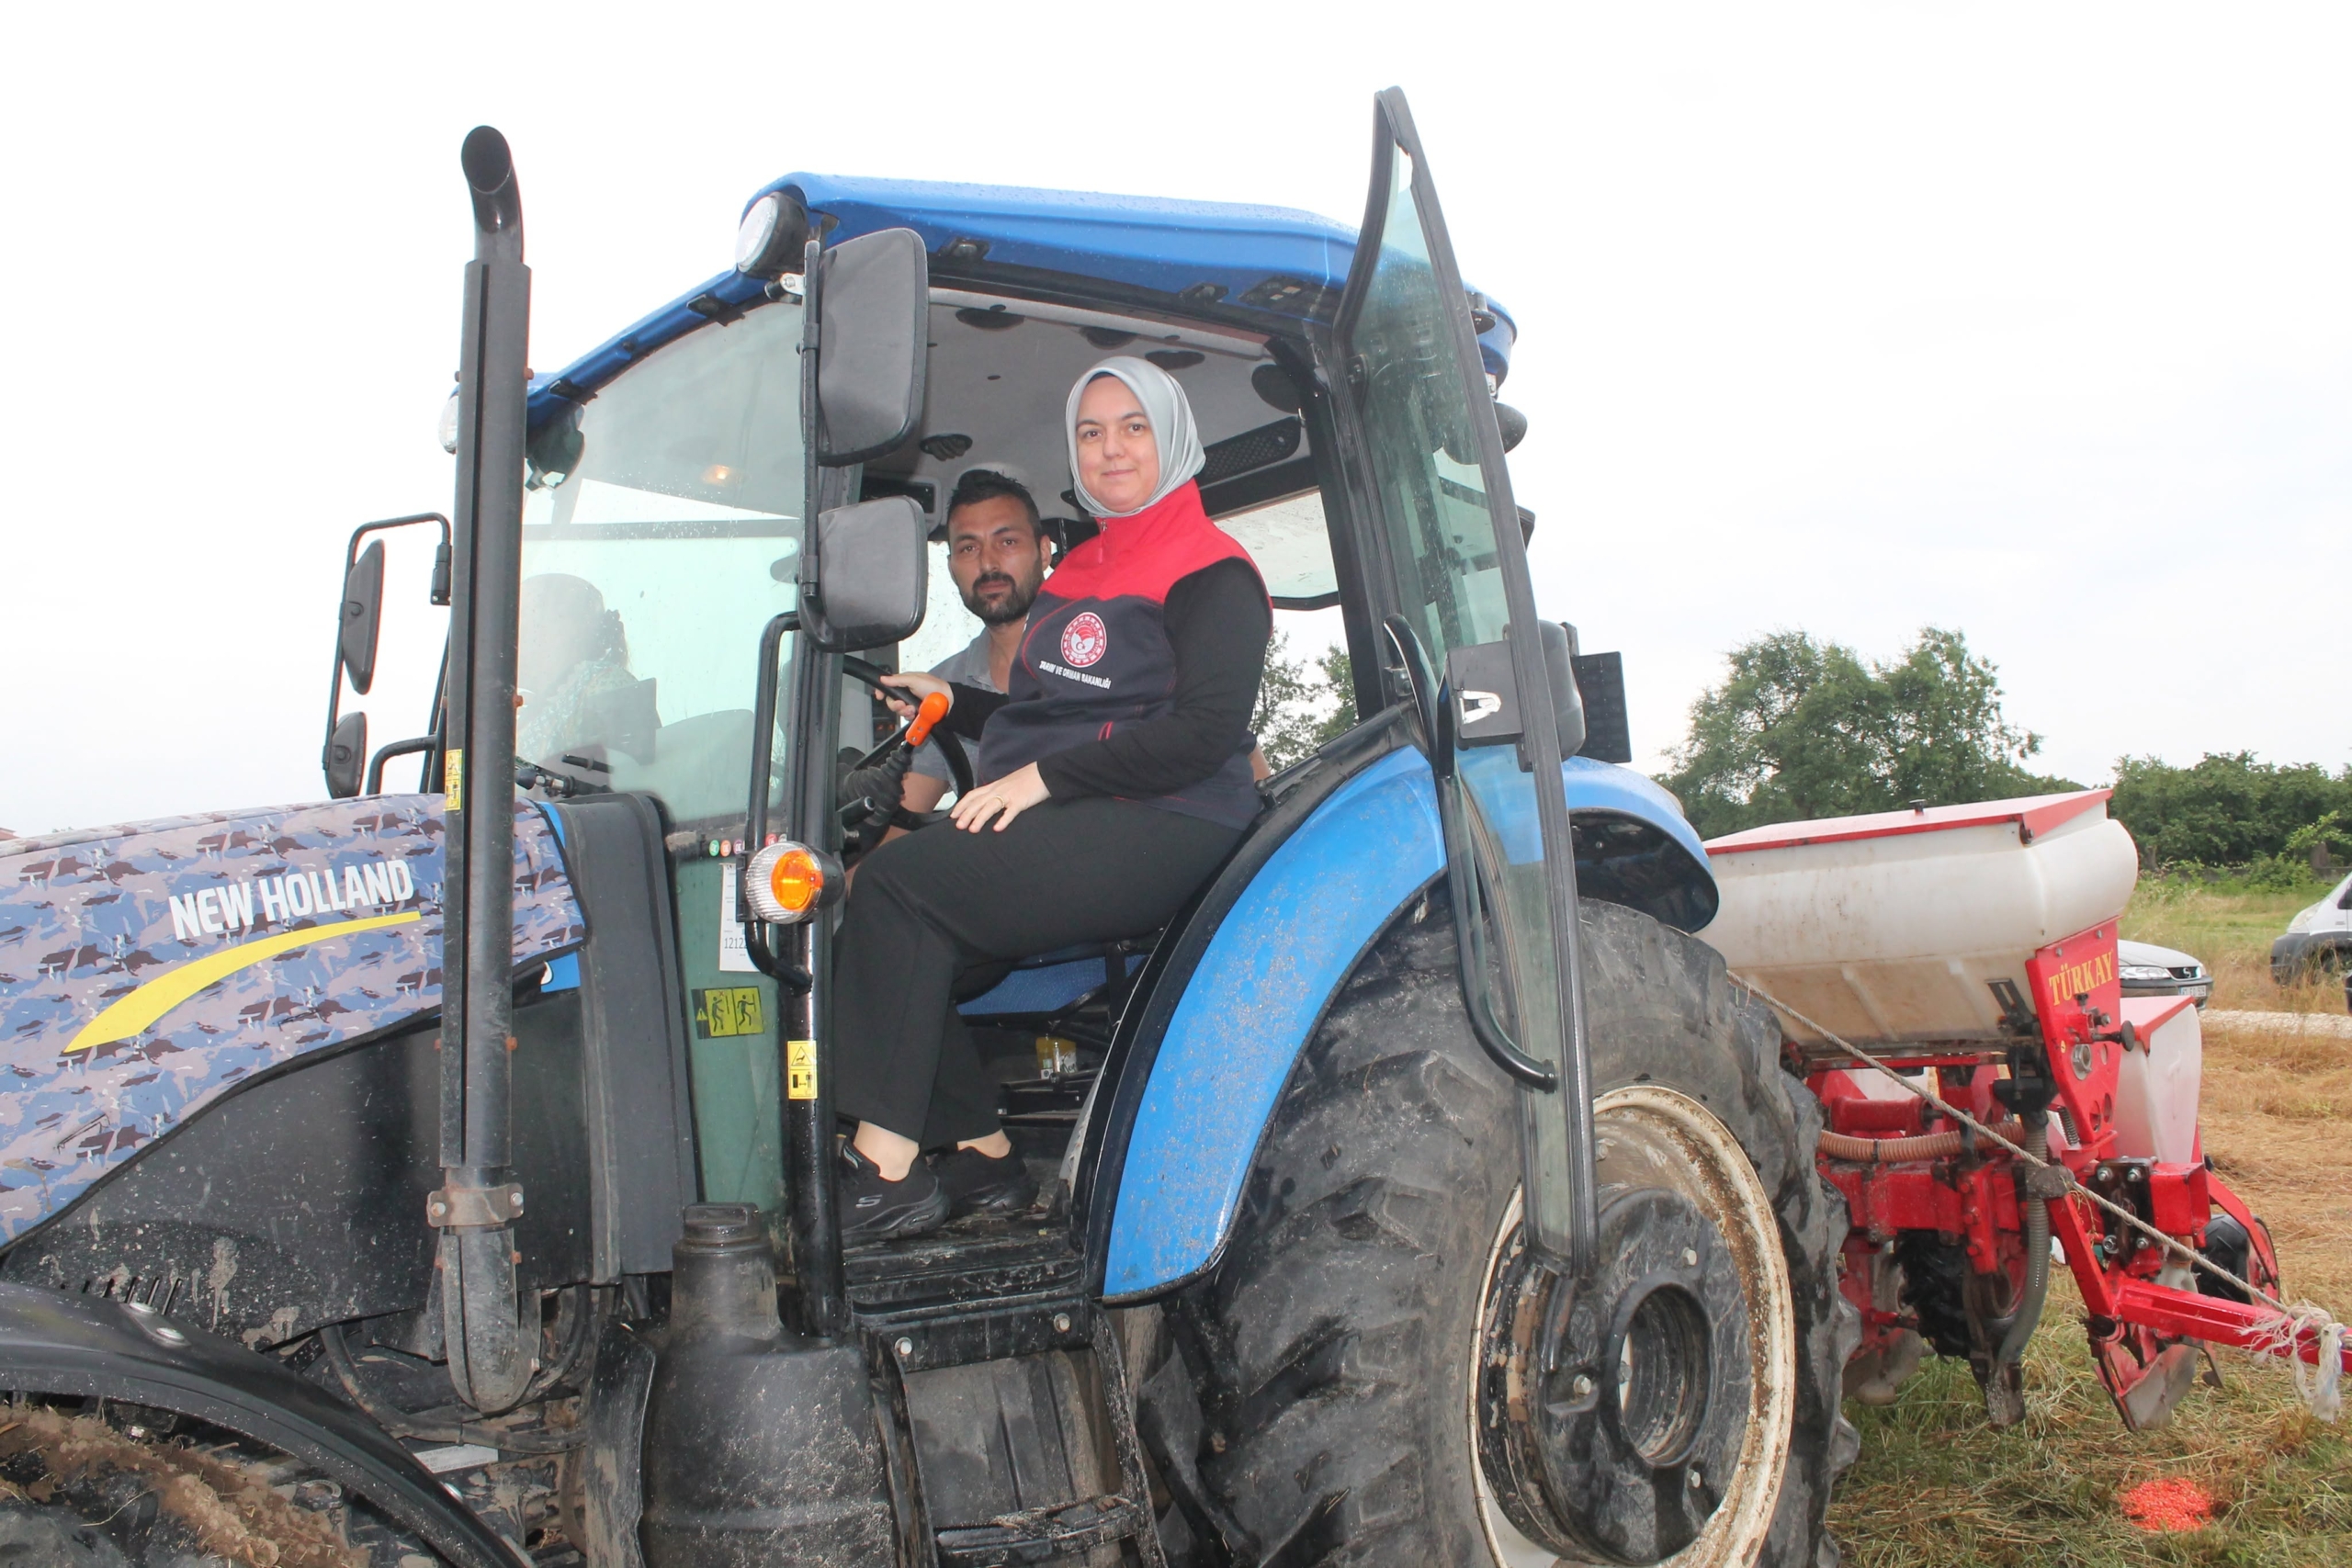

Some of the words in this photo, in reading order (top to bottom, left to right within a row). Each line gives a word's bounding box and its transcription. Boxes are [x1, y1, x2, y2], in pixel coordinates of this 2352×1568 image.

[1055, 665, 1063, 676] VE
[1062, 668, 1080, 682] ORMAN
[169, 882, 254, 940] NEW
[259, 860, 413, 921] HOLLAND
[2048, 951, 2113, 1006] TÜRKAY
